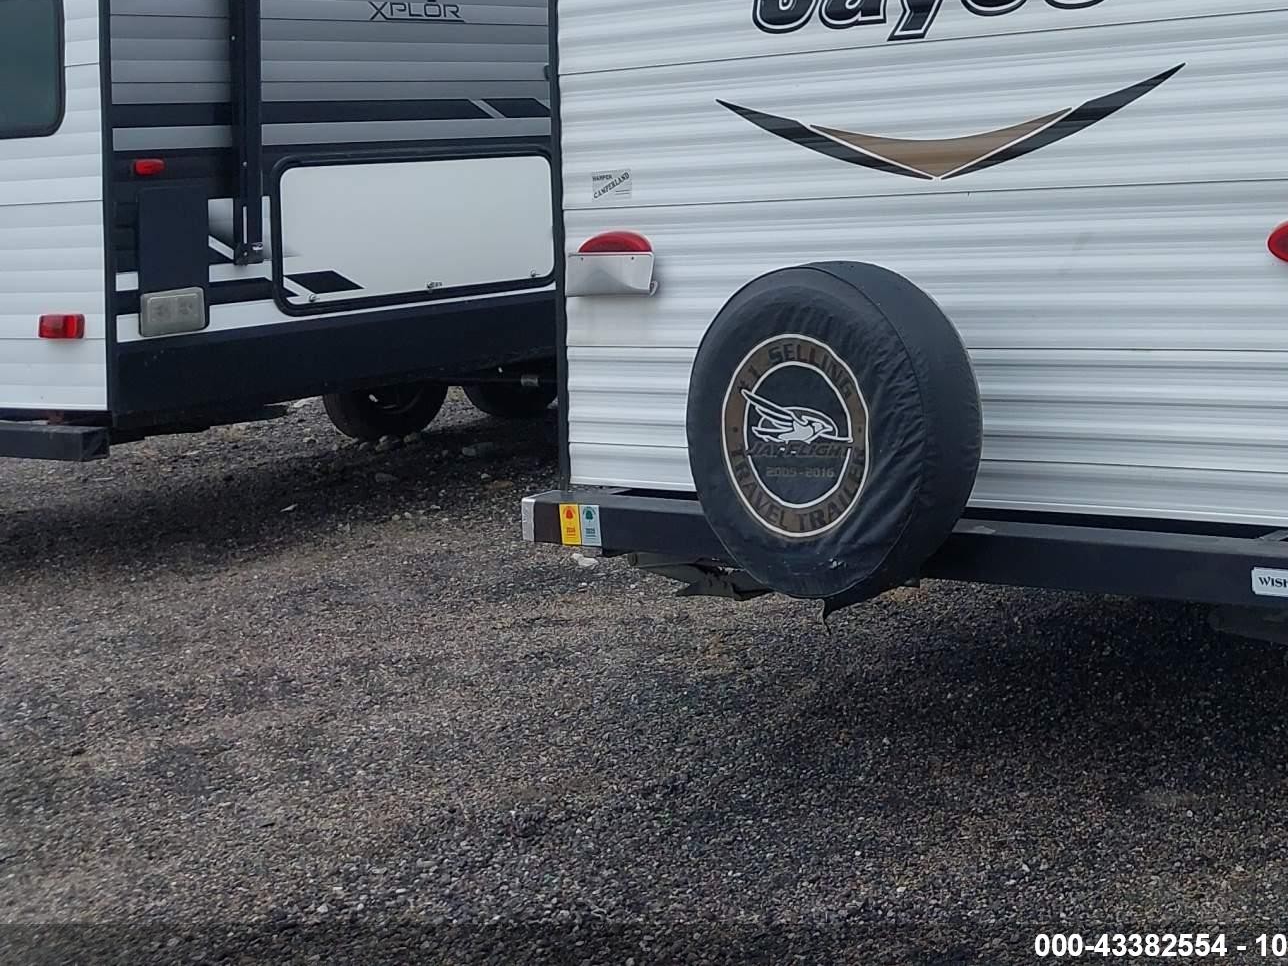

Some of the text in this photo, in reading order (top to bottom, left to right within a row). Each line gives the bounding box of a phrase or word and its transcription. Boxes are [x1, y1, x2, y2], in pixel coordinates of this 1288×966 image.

[768, 344, 853, 398] SELLING
[731, 442, 866, 531] TRAVEL TRAILER
